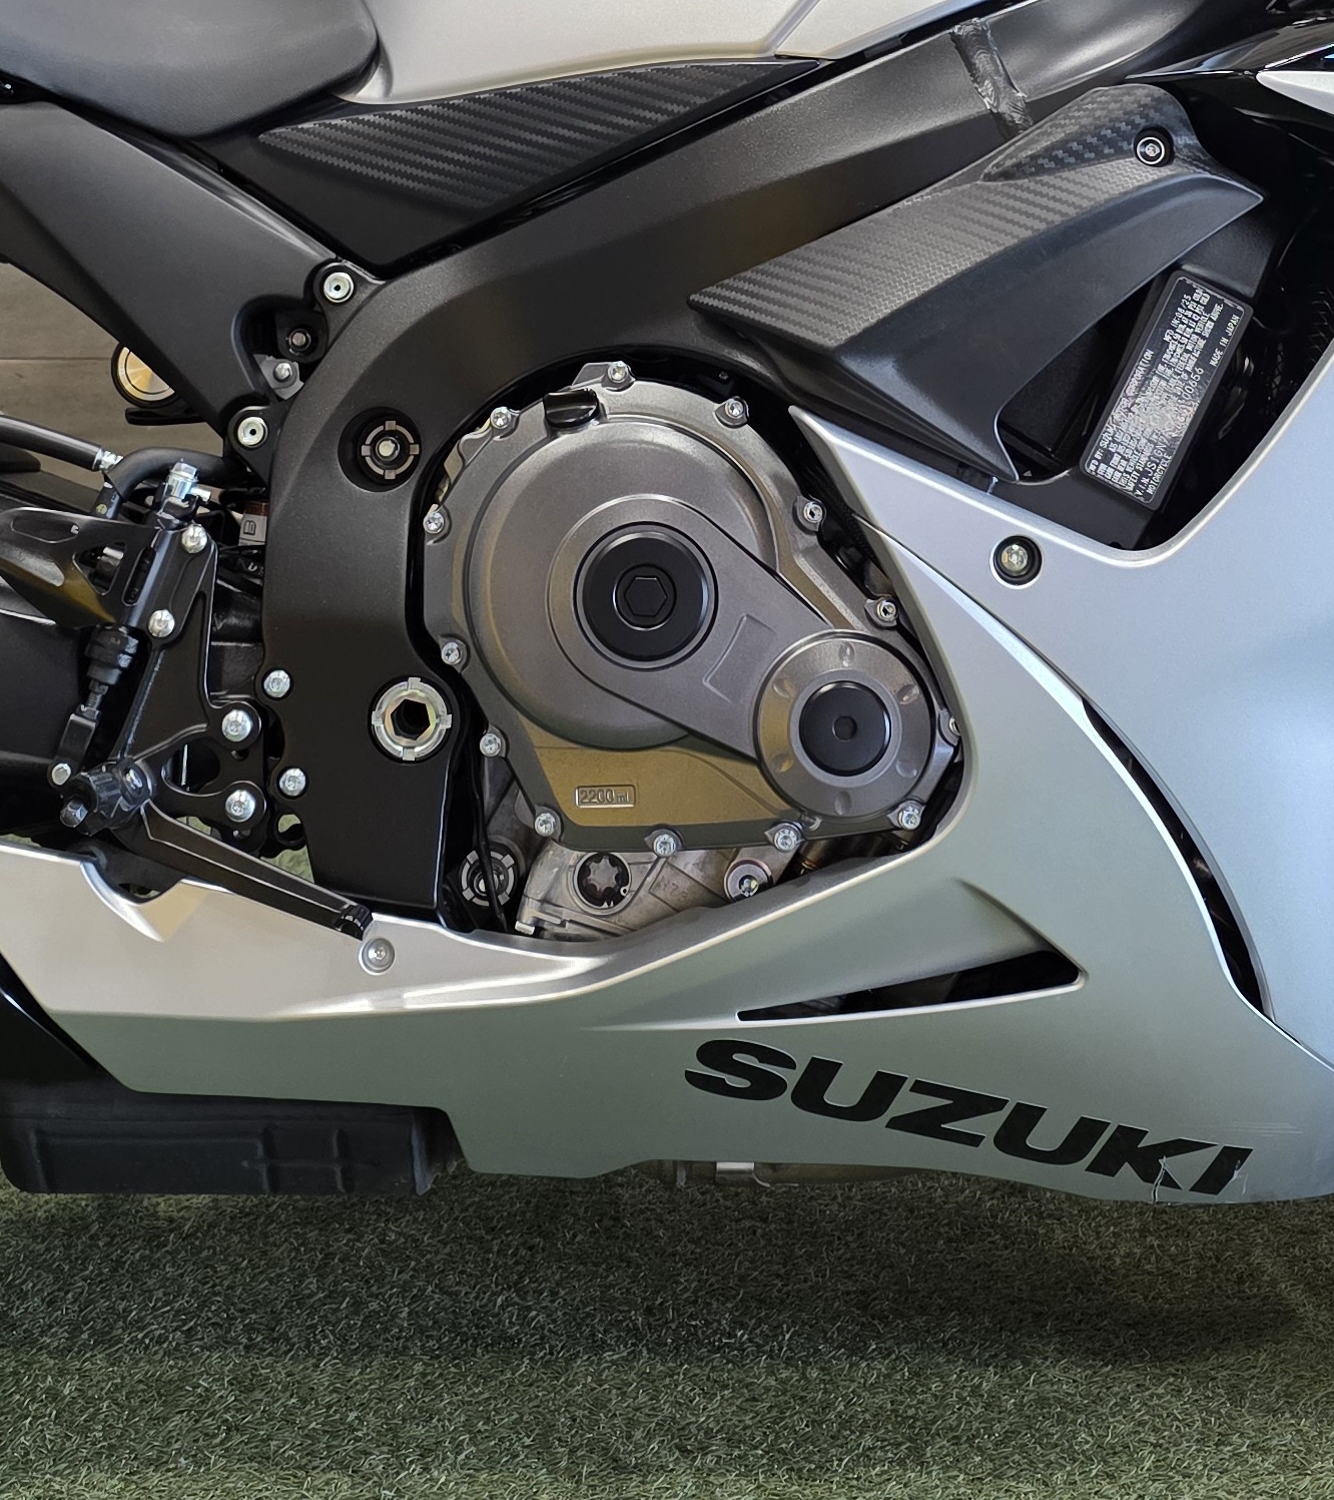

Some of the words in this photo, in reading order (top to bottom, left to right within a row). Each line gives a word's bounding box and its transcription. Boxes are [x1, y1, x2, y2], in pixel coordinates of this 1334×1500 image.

[1209, 348, 1223, 366] MADE
[1223, 313, 1241, 337] JAPAN
[1145, 452, 1172, 494] MOTORCYCLE
[580, 788, 615, 804] 2200
[618, 792, 629, 803] ml
[684, 1039, 1254, 1196] SUZUKI
